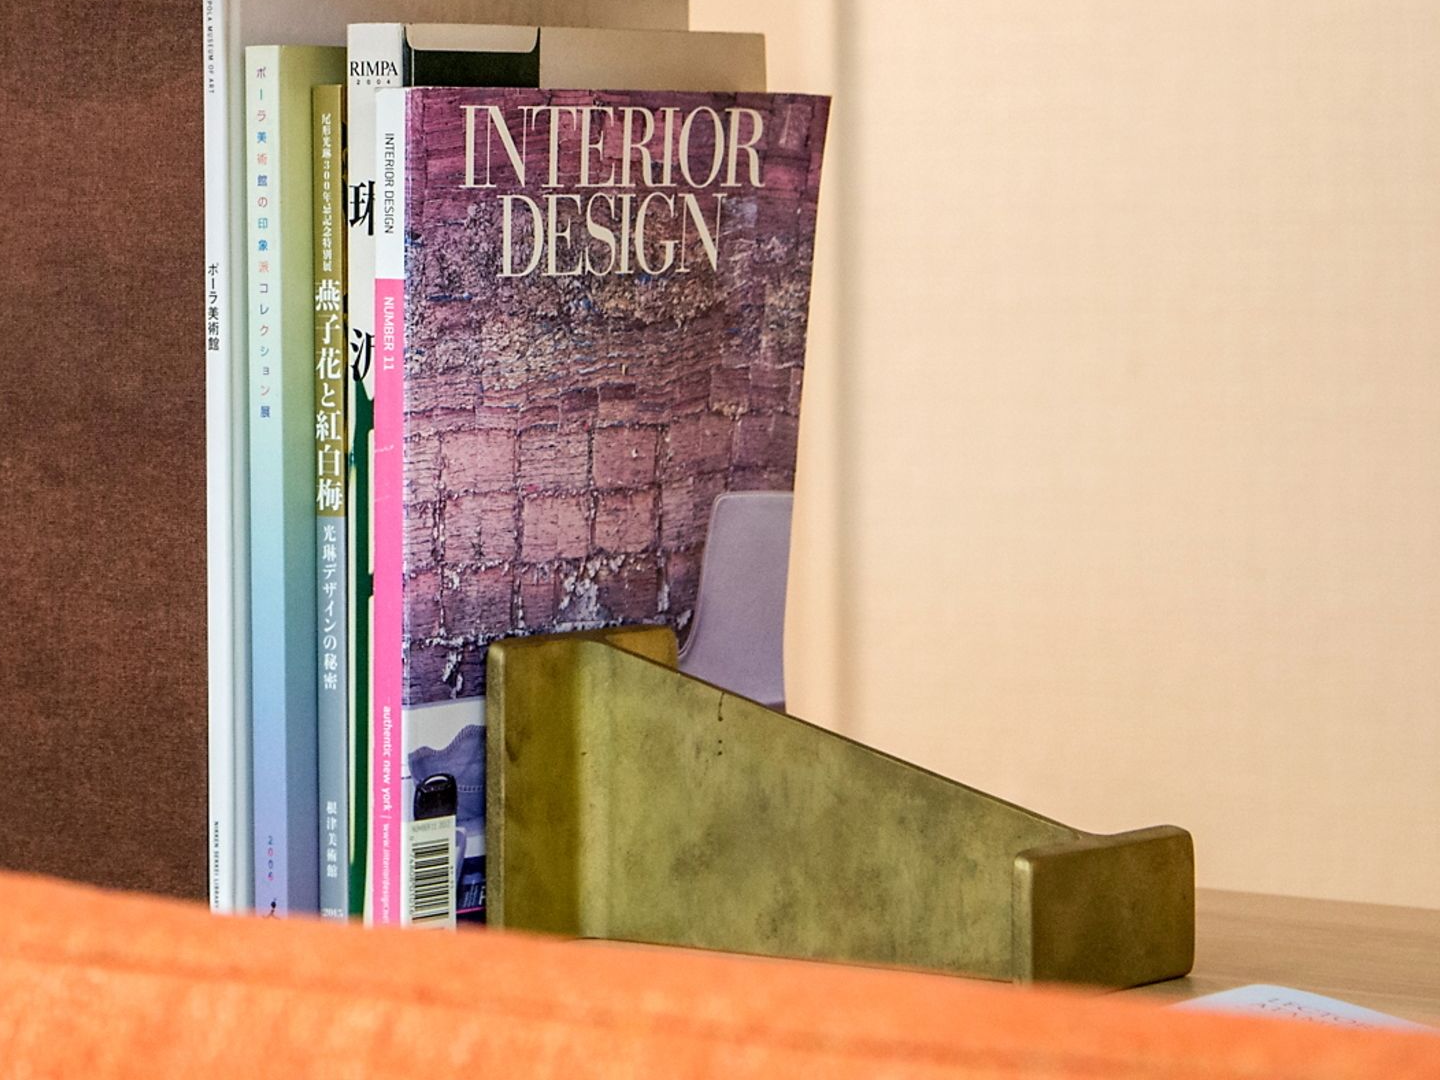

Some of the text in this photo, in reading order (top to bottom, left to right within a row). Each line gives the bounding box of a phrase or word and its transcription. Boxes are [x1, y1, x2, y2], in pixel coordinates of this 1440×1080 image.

[206, 0, 216, 94] POLA MUSEUM OF ART
[350, 60, 399, 77] RIMPA
[384, 132, 395, 235] INTERIOR DESIGN
[458, 104, 766, 189] INTERIOR
[256, 65, 271, 419] ポーラ美術館の印象派コレクション展
[496, 192, 728, 278] DESIGN
[207, 262, 220, 351] ポーラ美術館
[383, 296, 395, 371] NUMBER 11
[315, 278, 343, 511] 燕子花と紅白梅
[322, 523, 338, 690] 光琳デザインの秘密
[381, 705, 393, 812] authentic new york
[326, 800, 338, 879] 根津美術館
